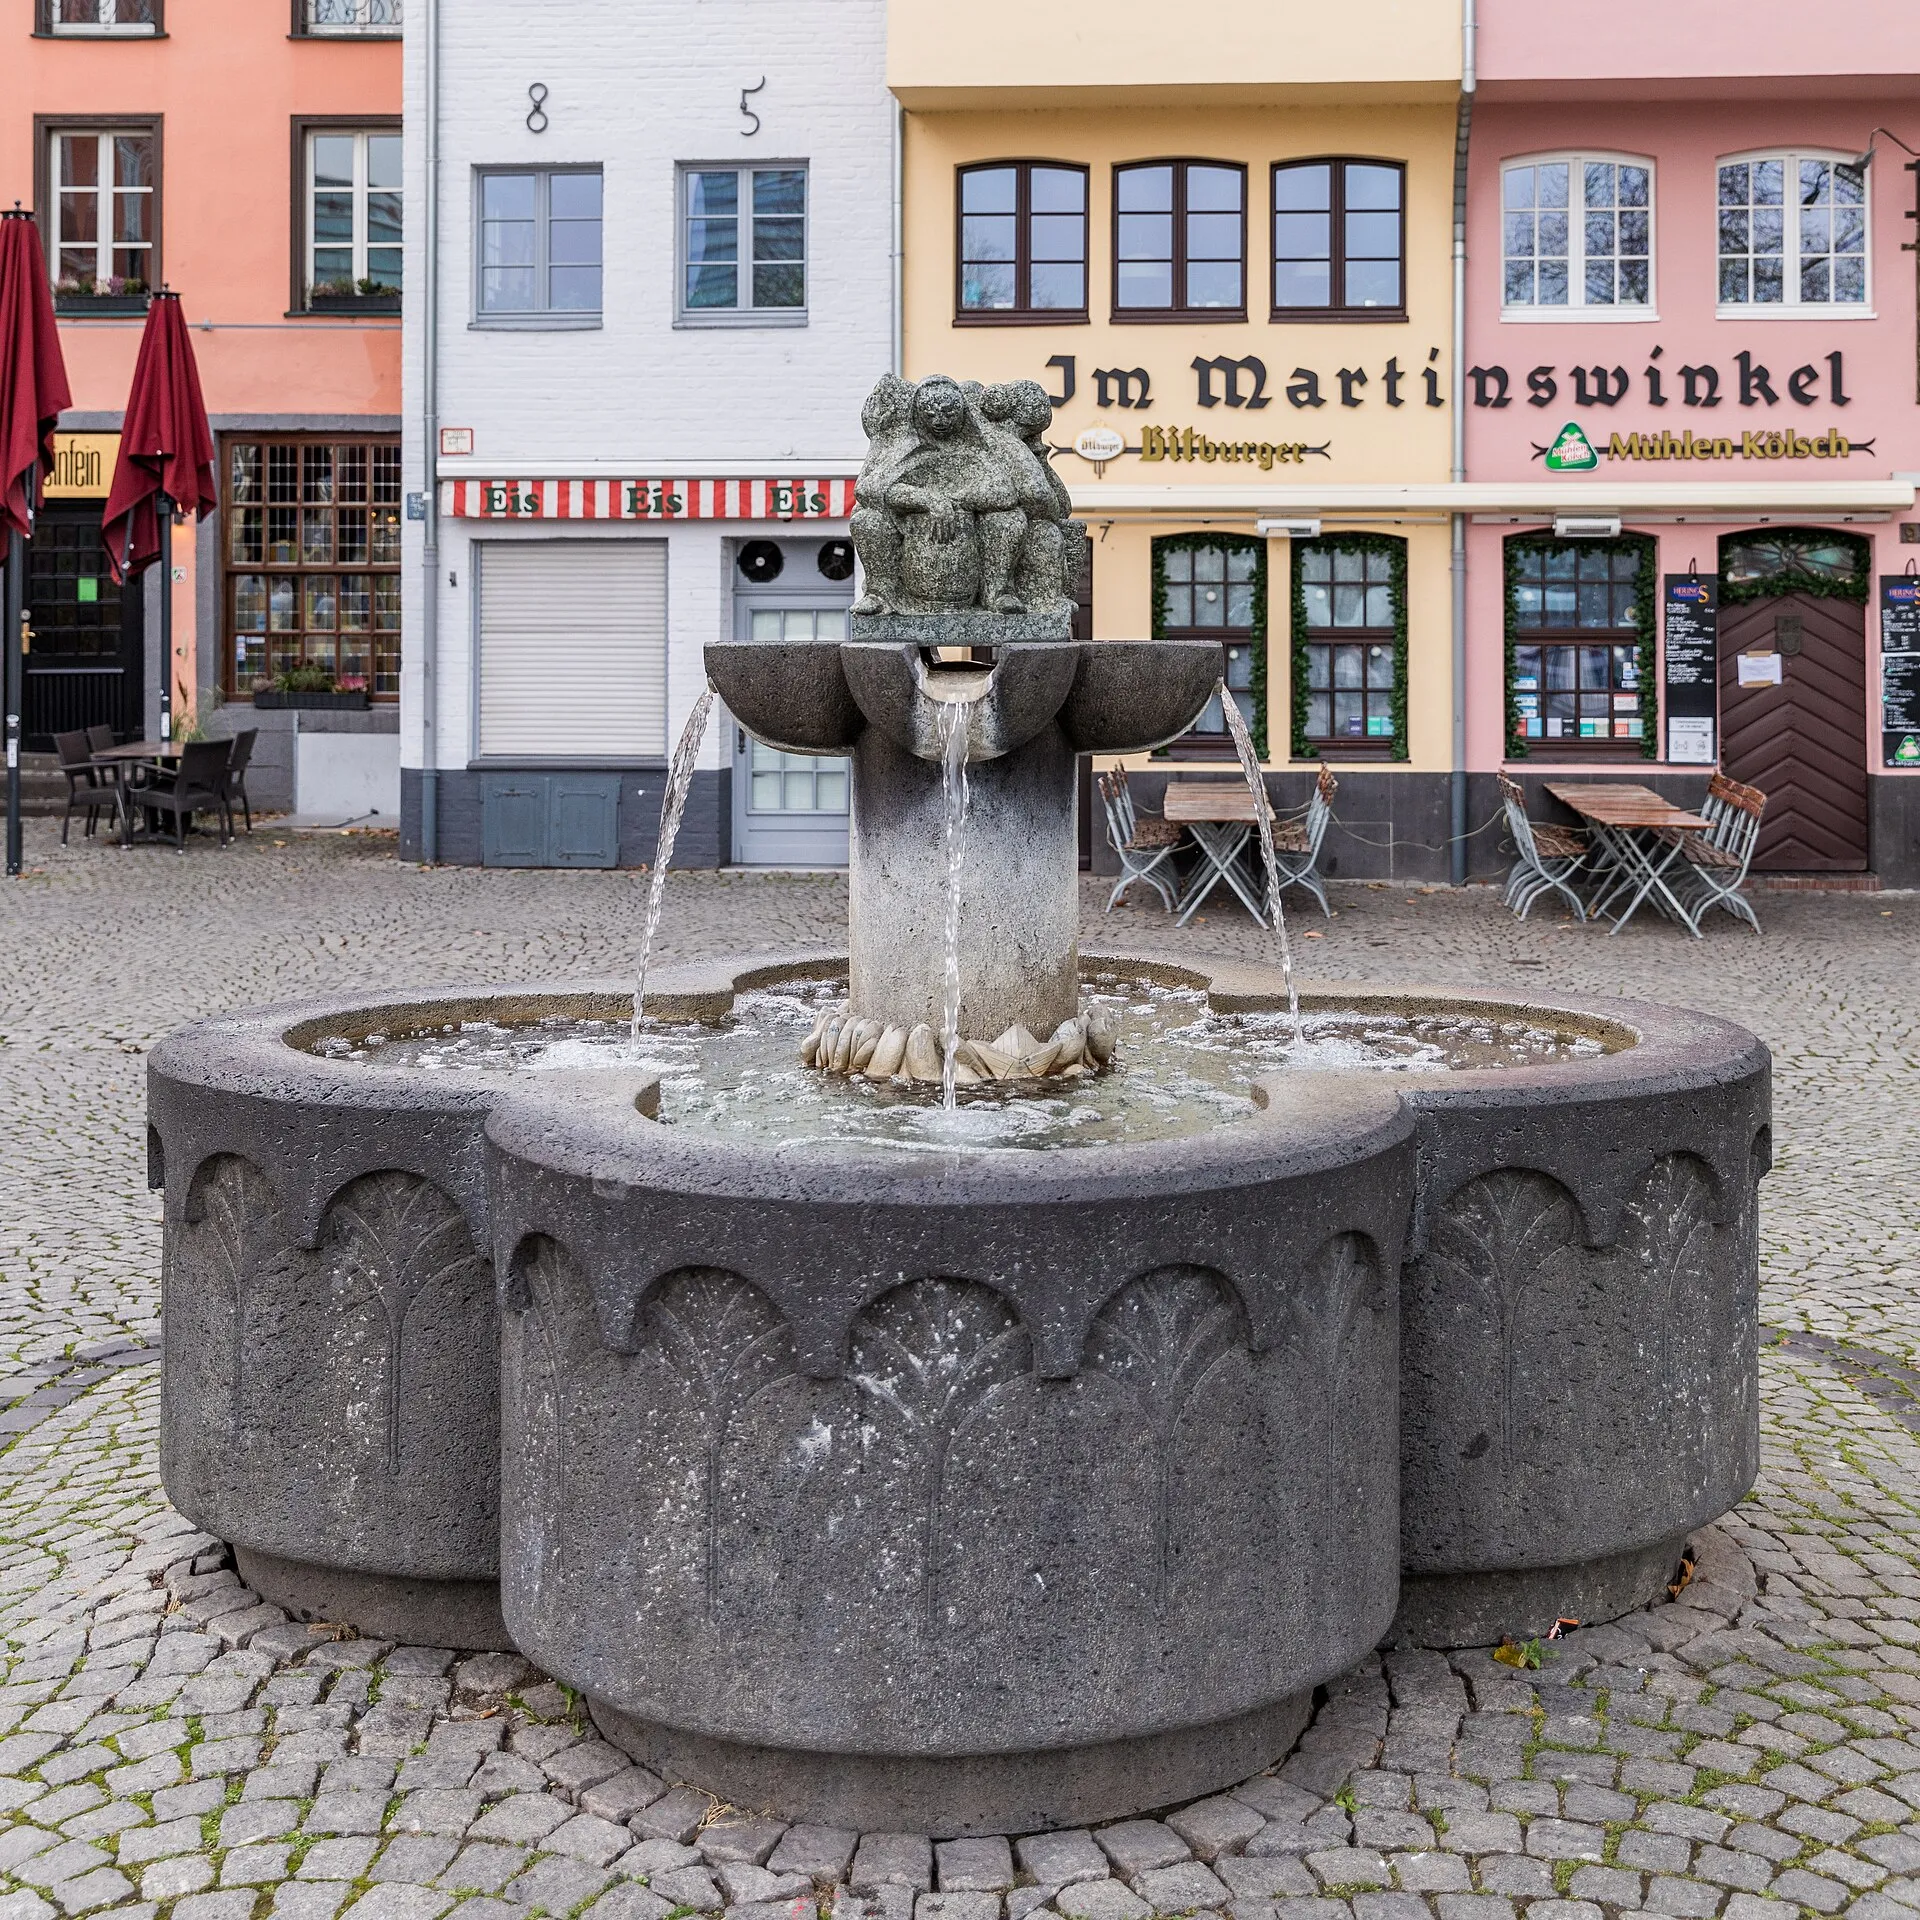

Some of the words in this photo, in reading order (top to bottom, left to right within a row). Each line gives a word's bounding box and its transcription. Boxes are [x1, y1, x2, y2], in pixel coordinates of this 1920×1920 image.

[1139, 425, 1307, 471] Bitburger
[1607, 430, 1733, 460] Mühlen
[1741, 428, 1849, 459] Kölsch
[484, 487, 539, 514] Eis
[627, 487, 682, 514] Eis
[770, 487, 826, 514] Eis
[1099, 525, 1110, 543] 7
